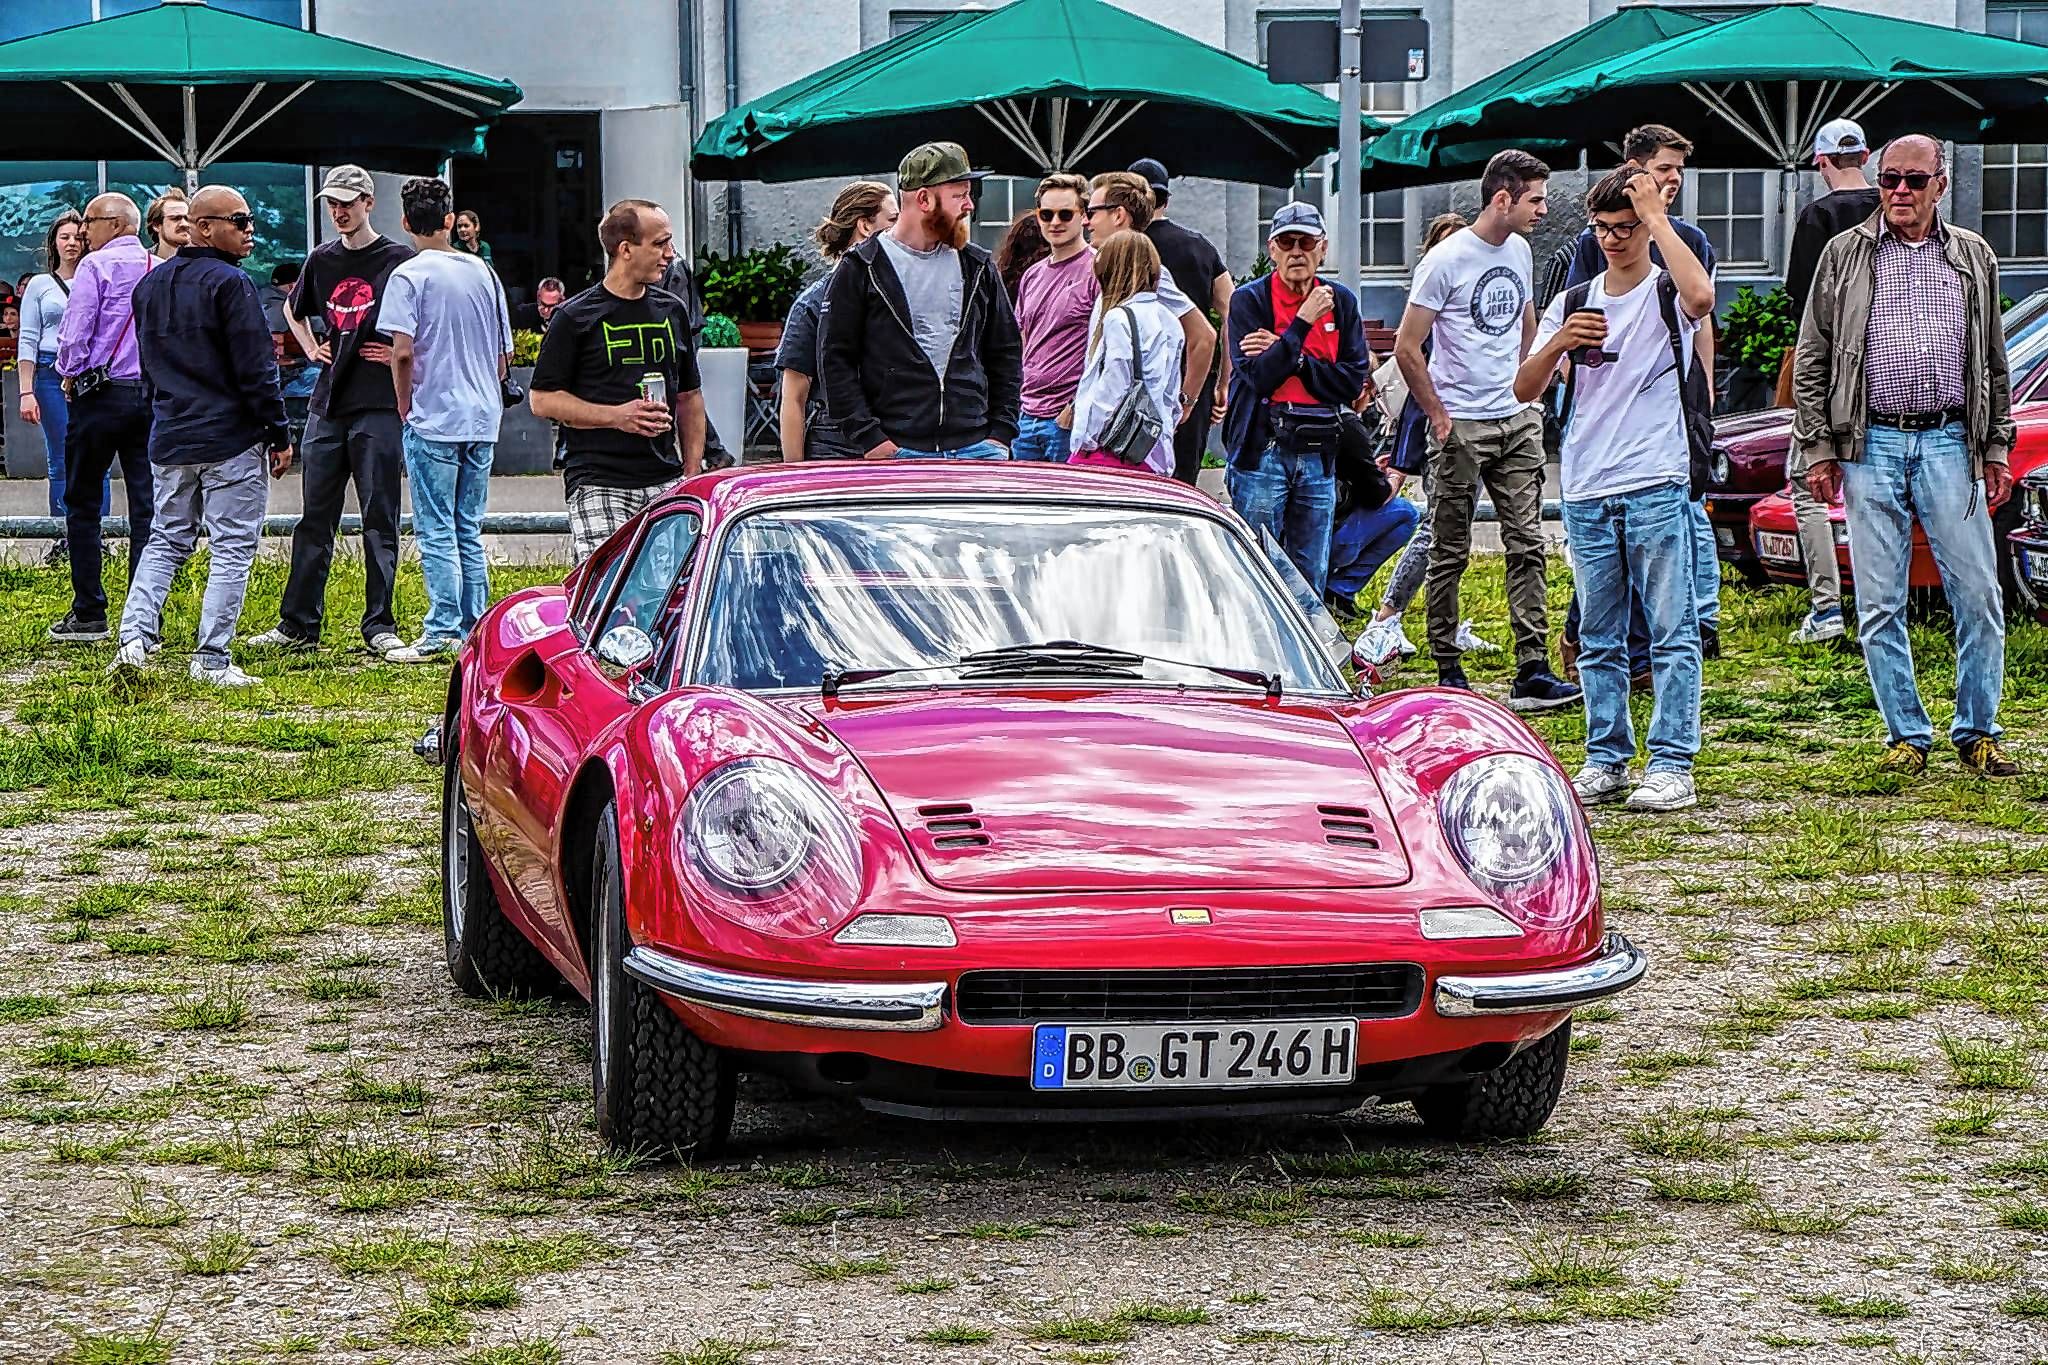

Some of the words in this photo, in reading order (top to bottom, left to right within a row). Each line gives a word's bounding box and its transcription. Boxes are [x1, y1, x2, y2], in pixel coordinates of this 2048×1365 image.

[1486, 290, 1508, 304] JACK
[1485, 302, 1515, 317] JONES
[1066, 1033, 1126, 1081] BB
[1159, 1031, 1220, 1080] GT
[1043, 1063, 1055, 1078] D
